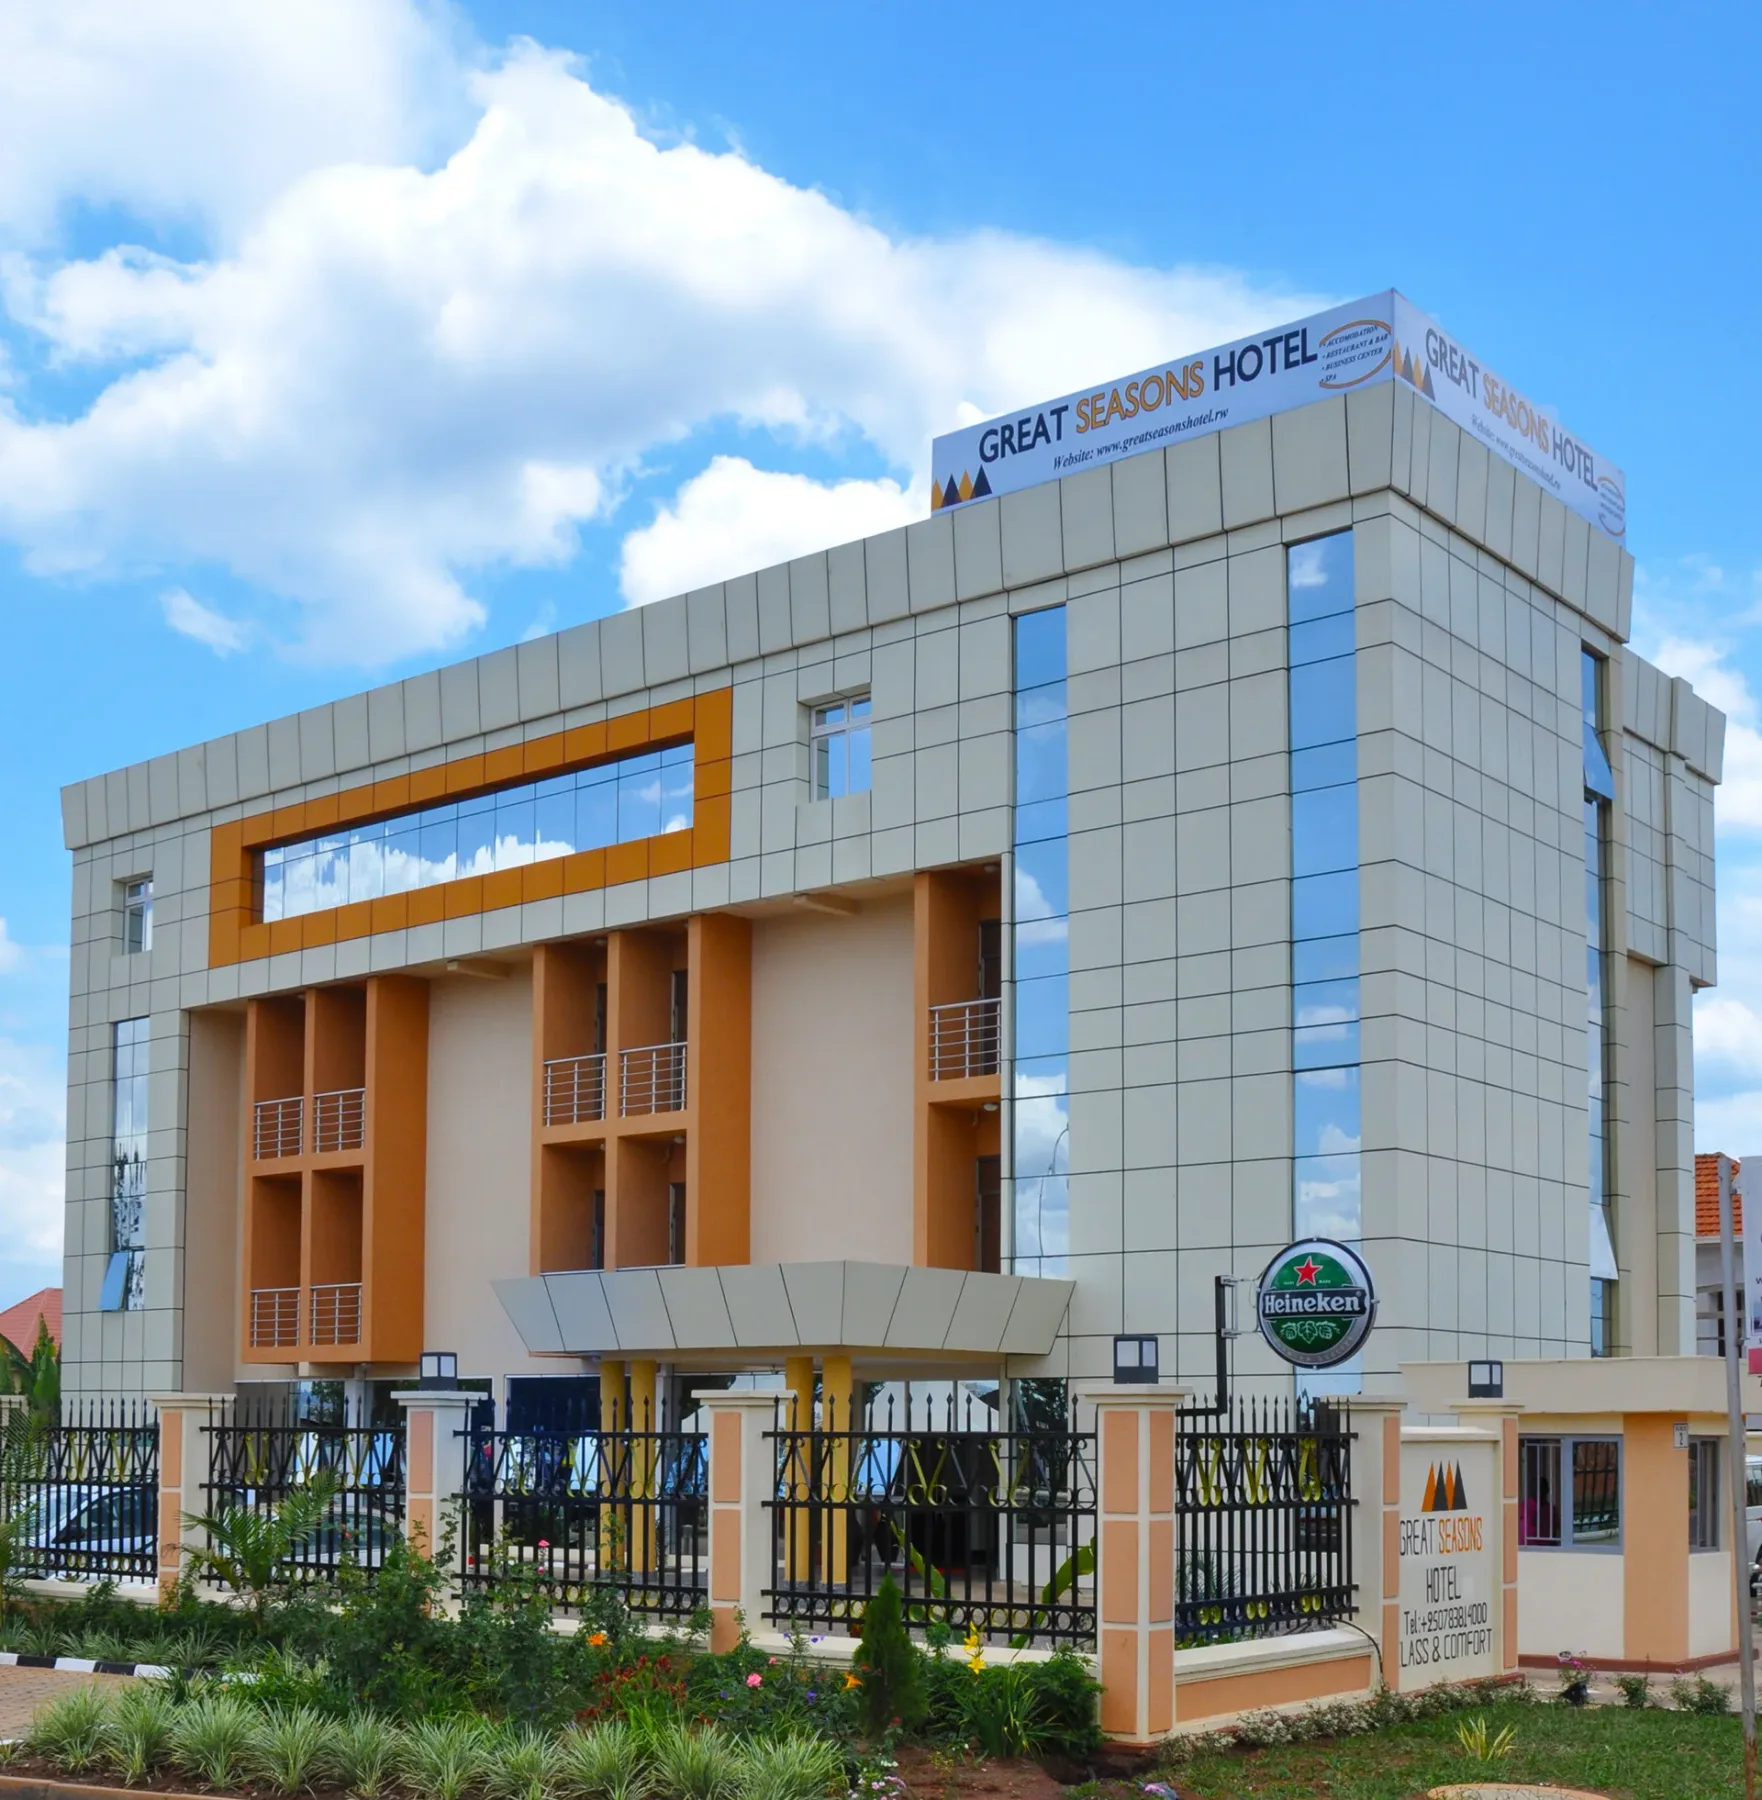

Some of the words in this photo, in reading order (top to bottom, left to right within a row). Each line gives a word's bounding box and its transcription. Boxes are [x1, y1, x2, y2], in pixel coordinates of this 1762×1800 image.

[1325, 354, 1357, 371] BUSINESS
[1357, 347, 1383, 361] CENTER
[1326, 340, 1368, 360] RESTAURANT
[1374, 333, 1389, 344] BAR
[979, 404, 1069, 463] GREAT
[1076, 361, 1204, 434] SEASONS
[1213, 327, 1318, 391] HOTEL
[1325, 373, 1337, 383] SPA
[1425, 327, 1480, 400] GREAT
[1482, 372, 1550, 454] SEASONS
[1552, 426, 1598, 492] HOTEL
[1053, 449, 1094, 470] Website:
[1097, 408, 1229, 456] www.greatseasonshotel.rw
[1264, 1292, 1360, 1314] Heineken
[1400, 1518, 1435, 1556] GREAT
[1439, 1516, 1483, 1554] SEASONS
[1426, 1566, 1461, 1604] HOTEL
[1399, 1637, 1429, 1668] LASS
[1432, 1636, 1441, 1662] &
[1444, 1628, 1492, 1660] COMFORT
